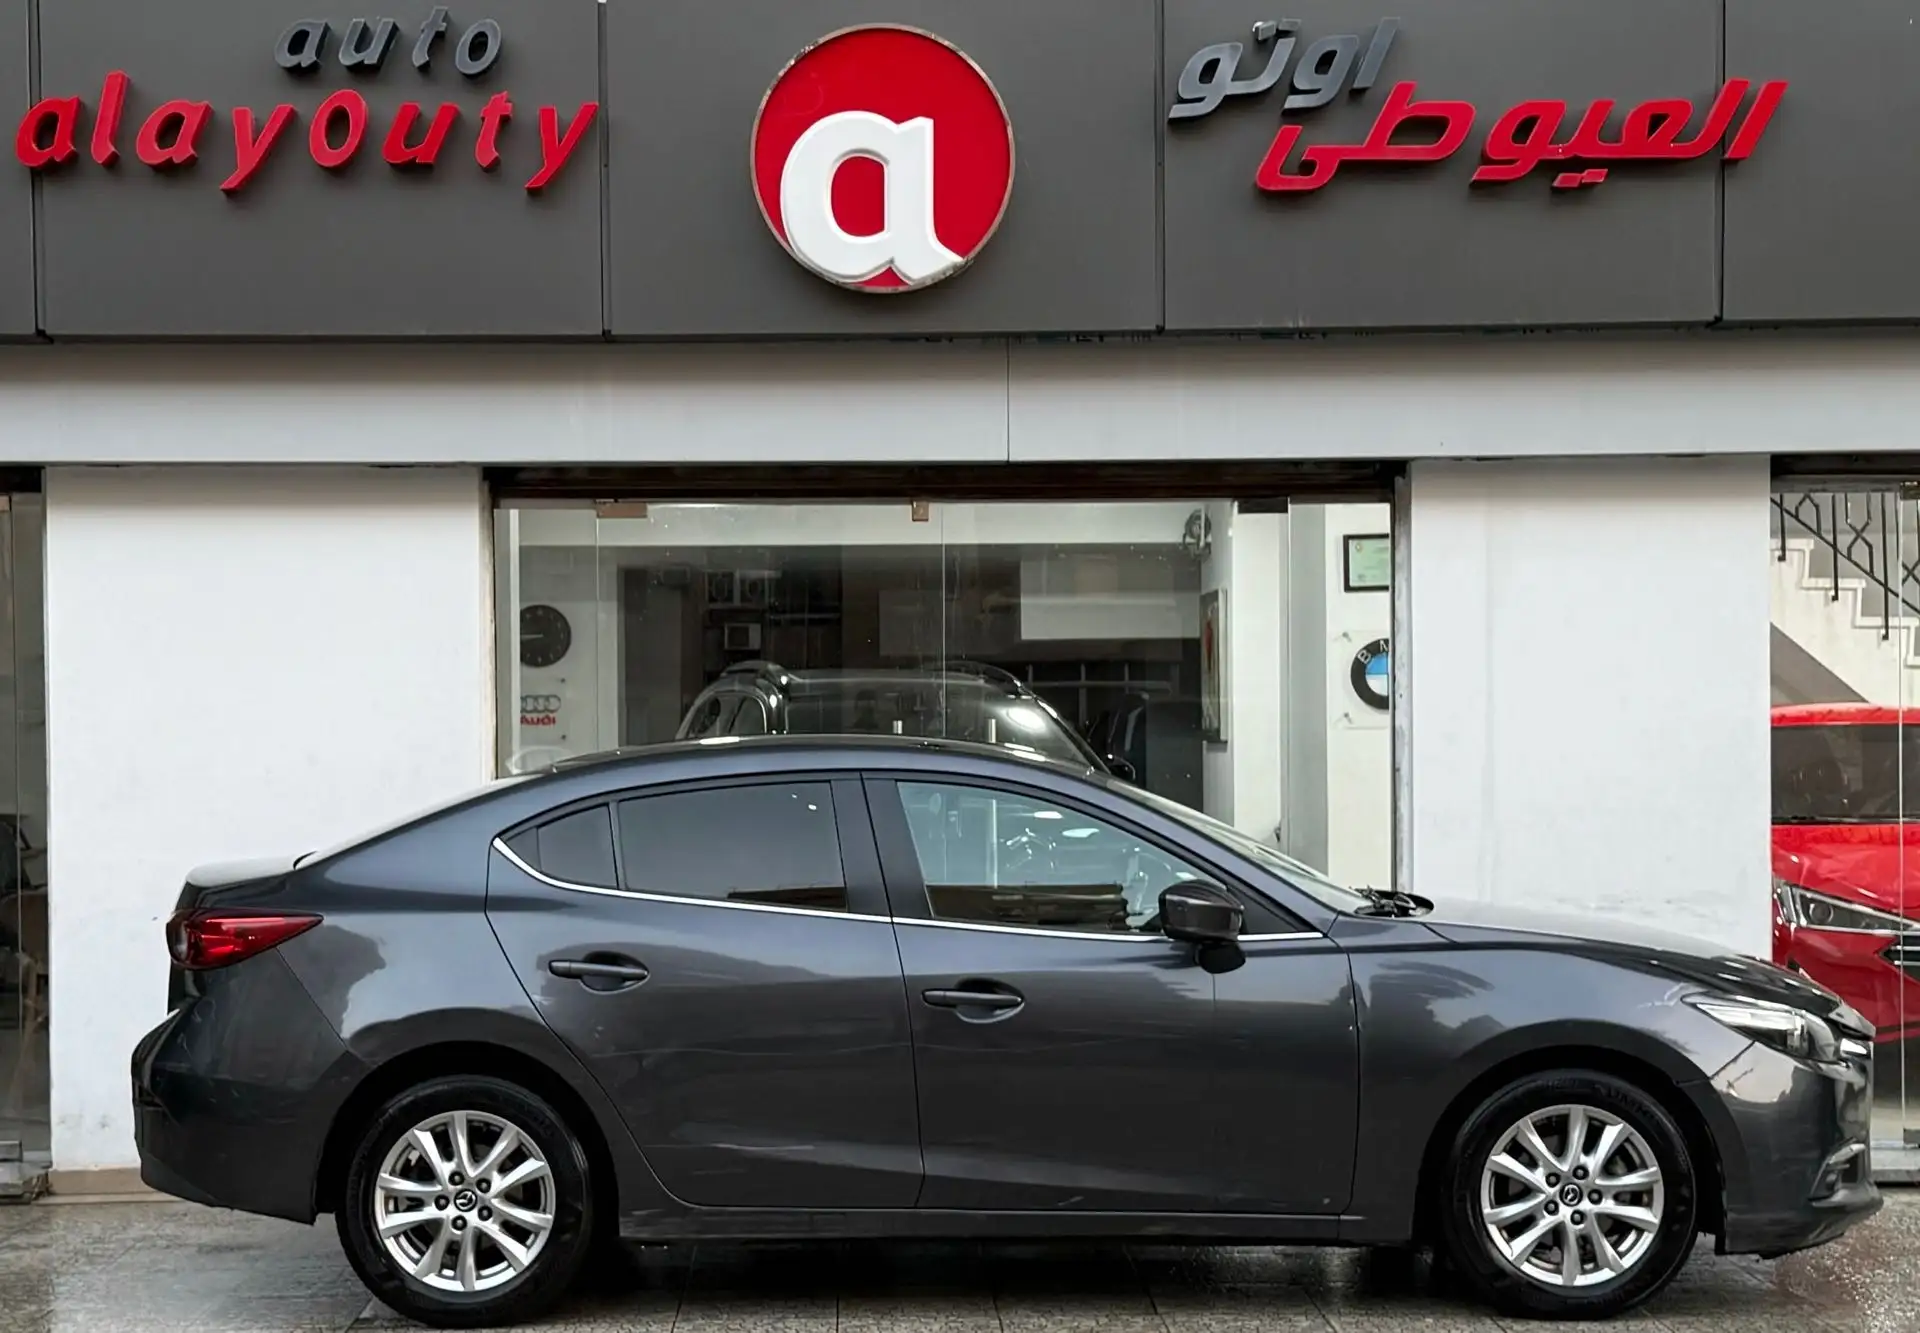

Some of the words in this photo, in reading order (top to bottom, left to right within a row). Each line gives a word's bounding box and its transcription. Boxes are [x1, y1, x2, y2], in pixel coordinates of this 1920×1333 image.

[274, 6, 502, 77] auto
[1168, 16, 1400, 119] اوتو
[15, 70, 599, 196] alayouty
[1256, 78, 1788, 191] العيوطى
[779, 109, 966, 286] a
